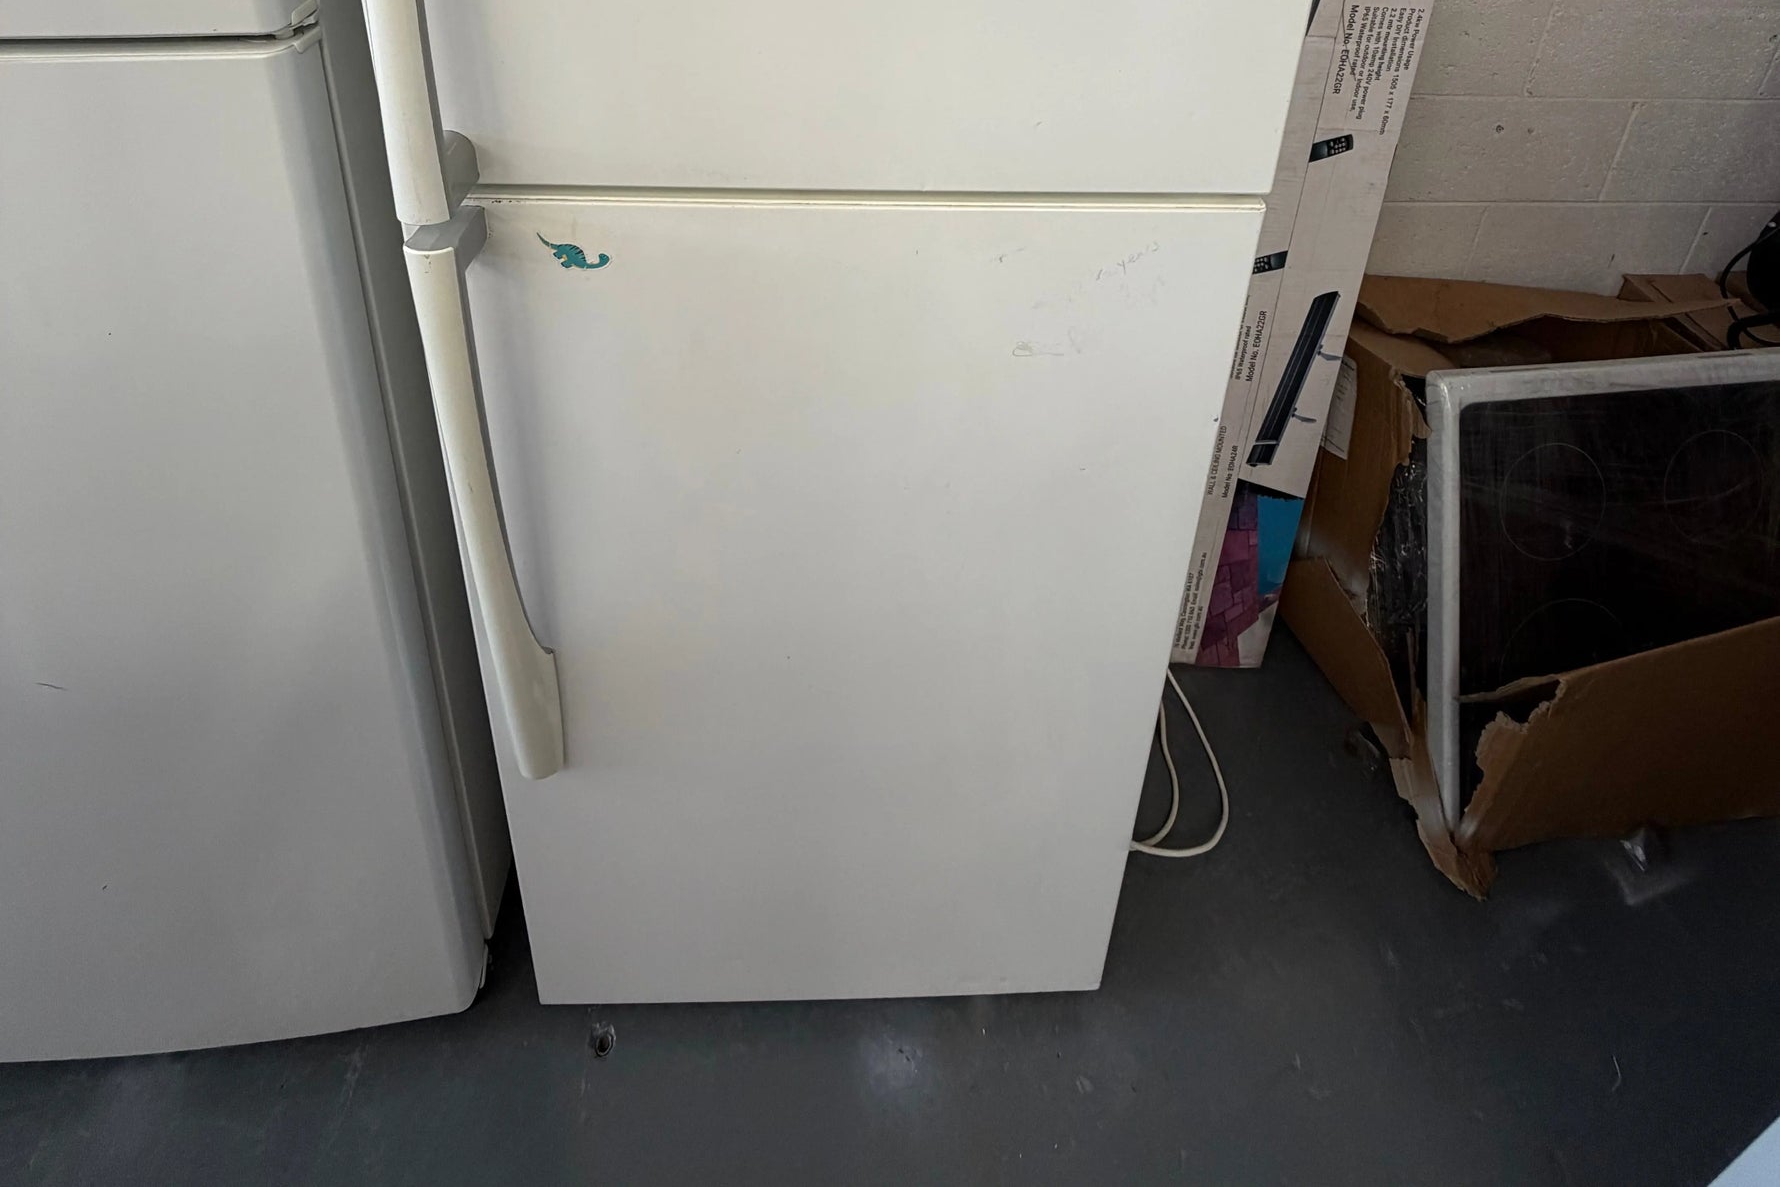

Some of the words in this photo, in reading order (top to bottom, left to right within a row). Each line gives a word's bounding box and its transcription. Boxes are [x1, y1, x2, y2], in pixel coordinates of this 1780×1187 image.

[1346, 4, 1359, 31] Model
[1367, 6, 1379, 33] Suitable
[1377, 5, 1388, 30] Comes
[1396, 6, 1406, 23] Easy
[1403, 7, 1416, 34] Product
[1352, 22, 1366, 57] Waterproof
[1365, 33, 1373, 43] for
[1373, 30, 1382, 45] with
[1378, 31, 1391, 61] mounting
[1408, 28, 1419, 49] Power
[1359, 44, 1371, 69] outdoor
[1402, 49, 1414, 71] Usage
[1357, 69, 1363, 77] or
[1373, 61, 1384, 81] height
[1359, 85, 1369, 105] power
[1355, 105, 1365, 119] plug
[1250, 348, 1259, 360] No.
[1245, 361, 1256, 382] Model
